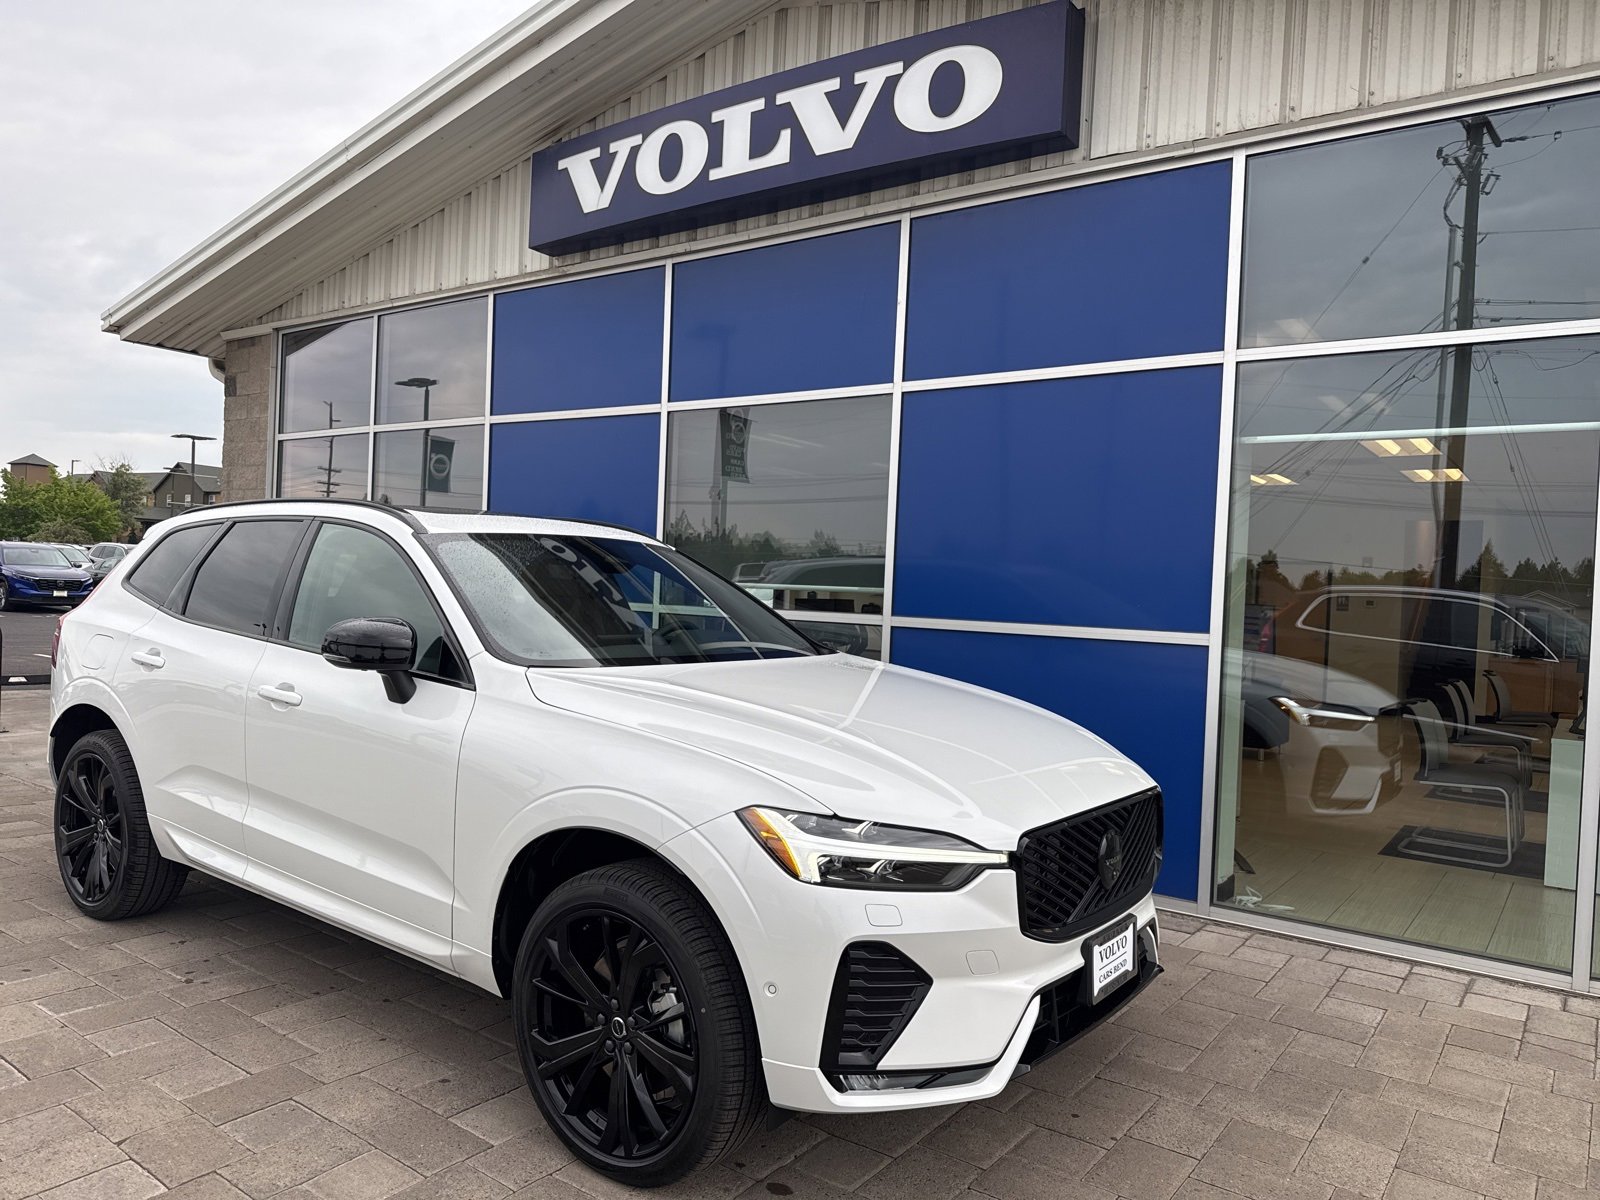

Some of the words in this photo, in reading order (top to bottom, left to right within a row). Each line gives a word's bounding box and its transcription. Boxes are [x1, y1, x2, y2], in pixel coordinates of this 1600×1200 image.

[557, 44, 1003, 214] VOLVO
[1099, 935, 1127, 963] VOLVO
[1098, 968, 1113, 984] CARS
[1113, 958, 1128, 974] BEND
